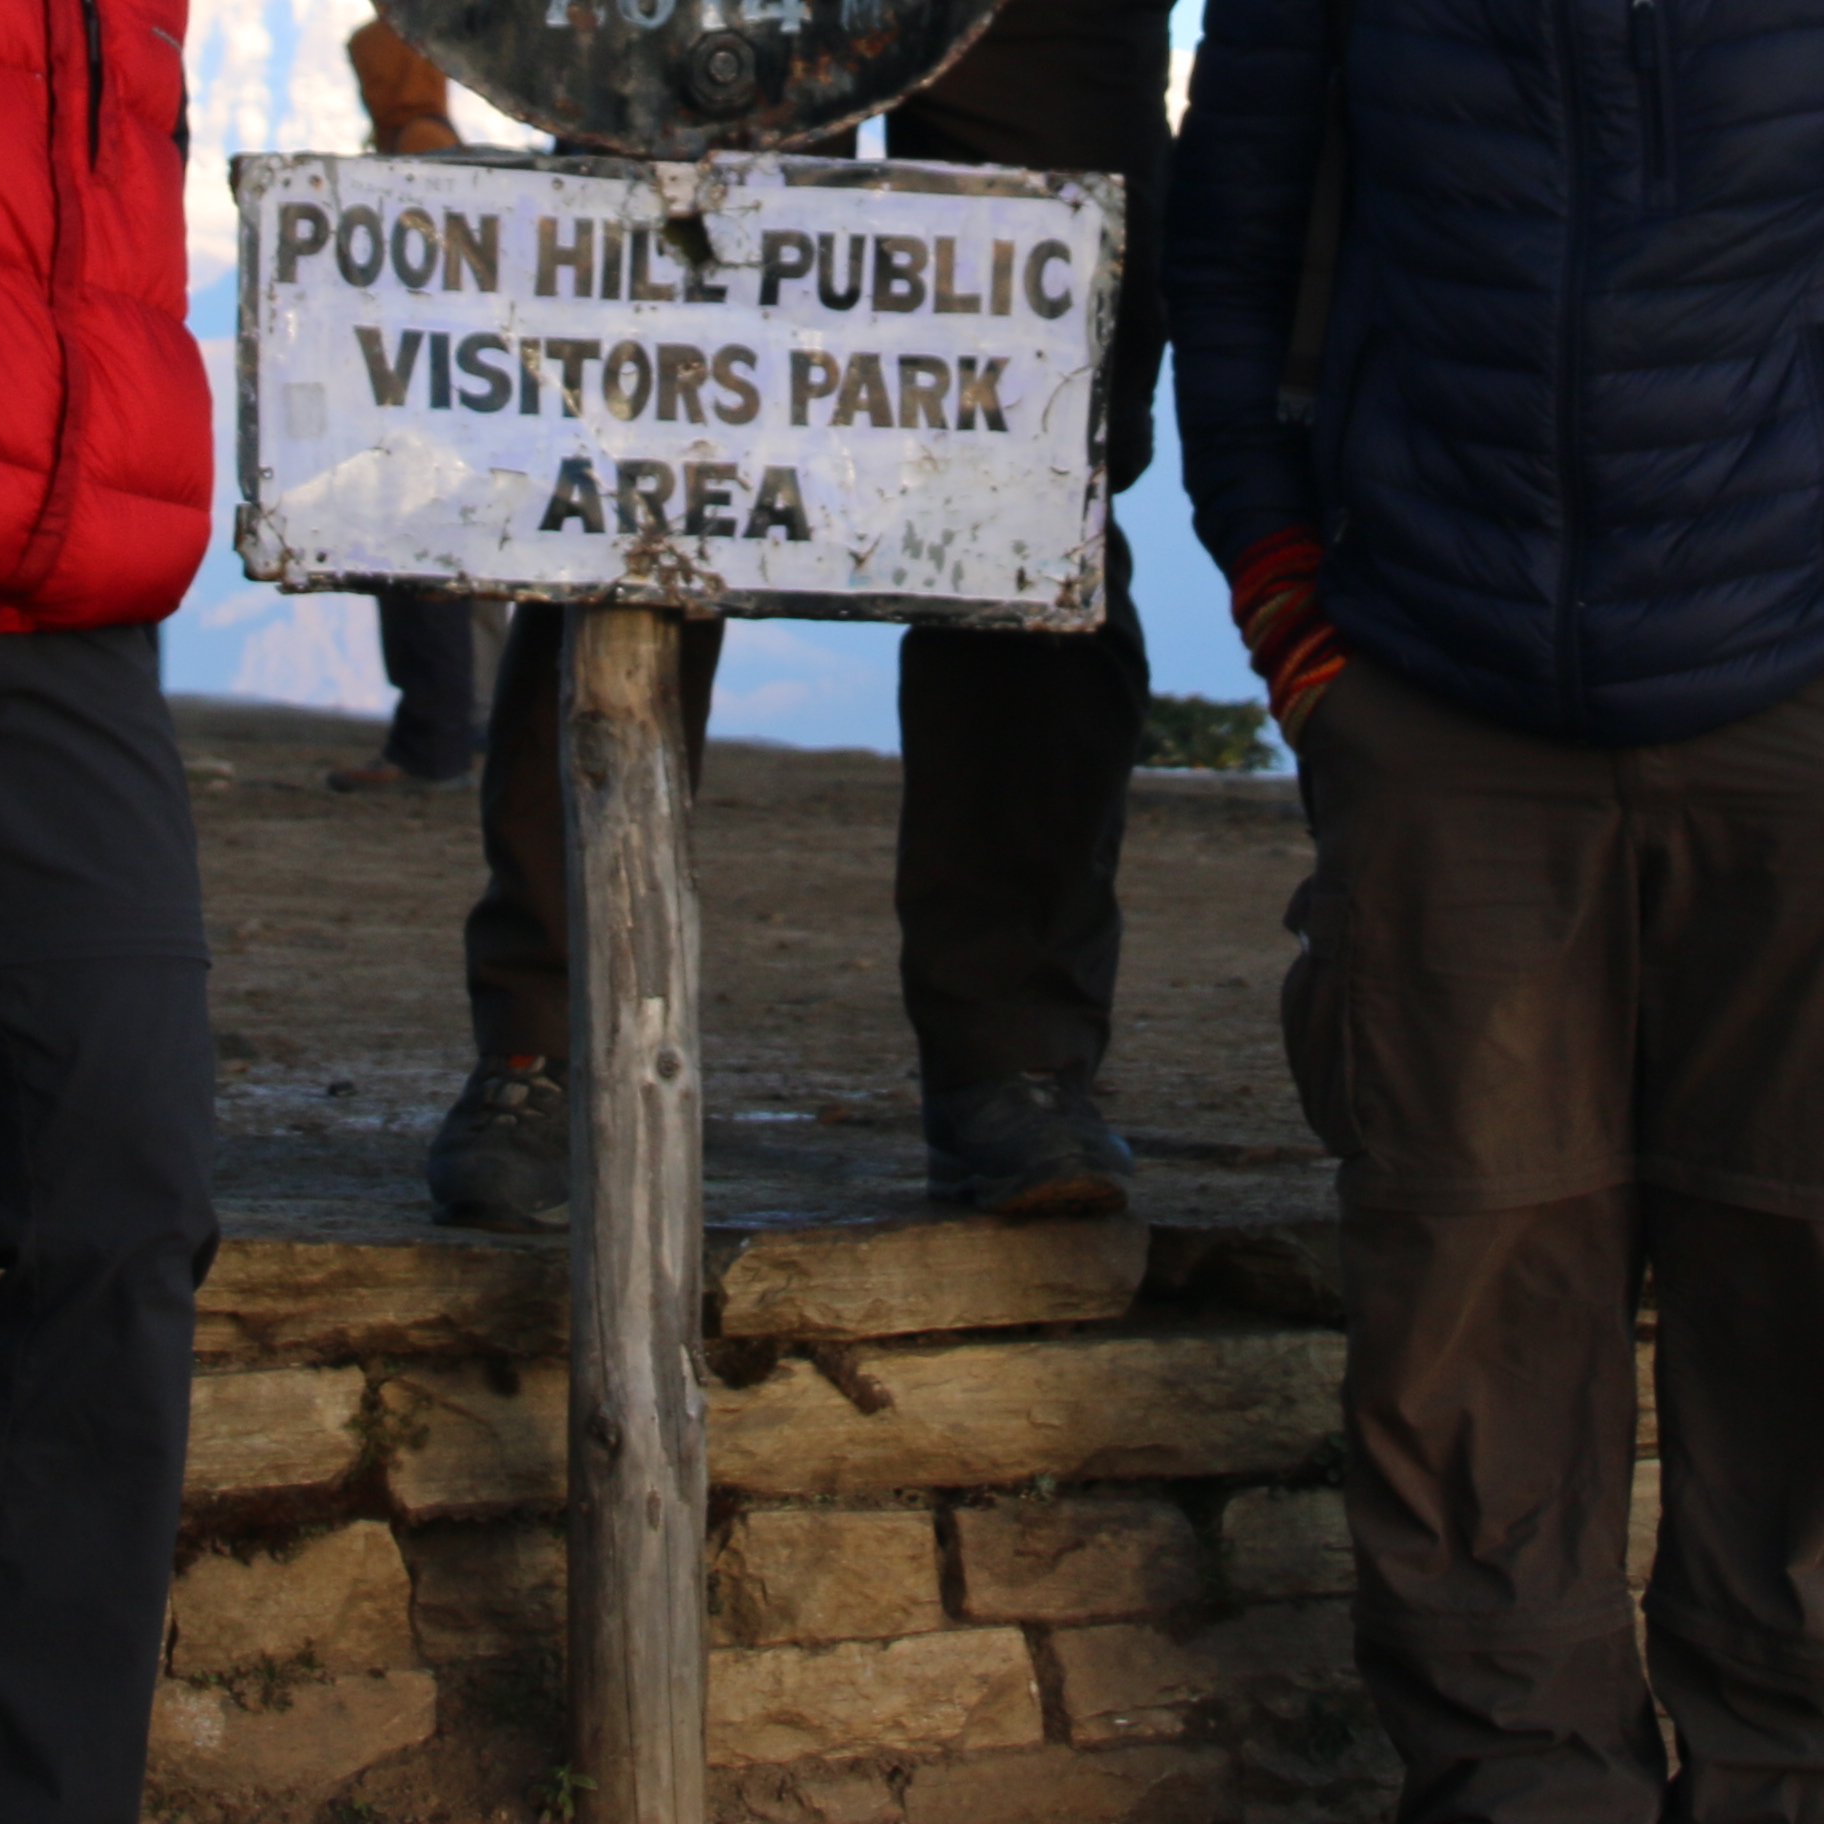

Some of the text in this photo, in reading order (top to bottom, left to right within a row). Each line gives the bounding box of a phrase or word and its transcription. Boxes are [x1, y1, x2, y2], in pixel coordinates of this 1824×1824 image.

[277, 202, 499, 293] POON
[758, 230, 1073, 320] PUBLIC
[355, 326, 1011, 433] VISITORS PARK
[538, 456, 811, 542] AREA
